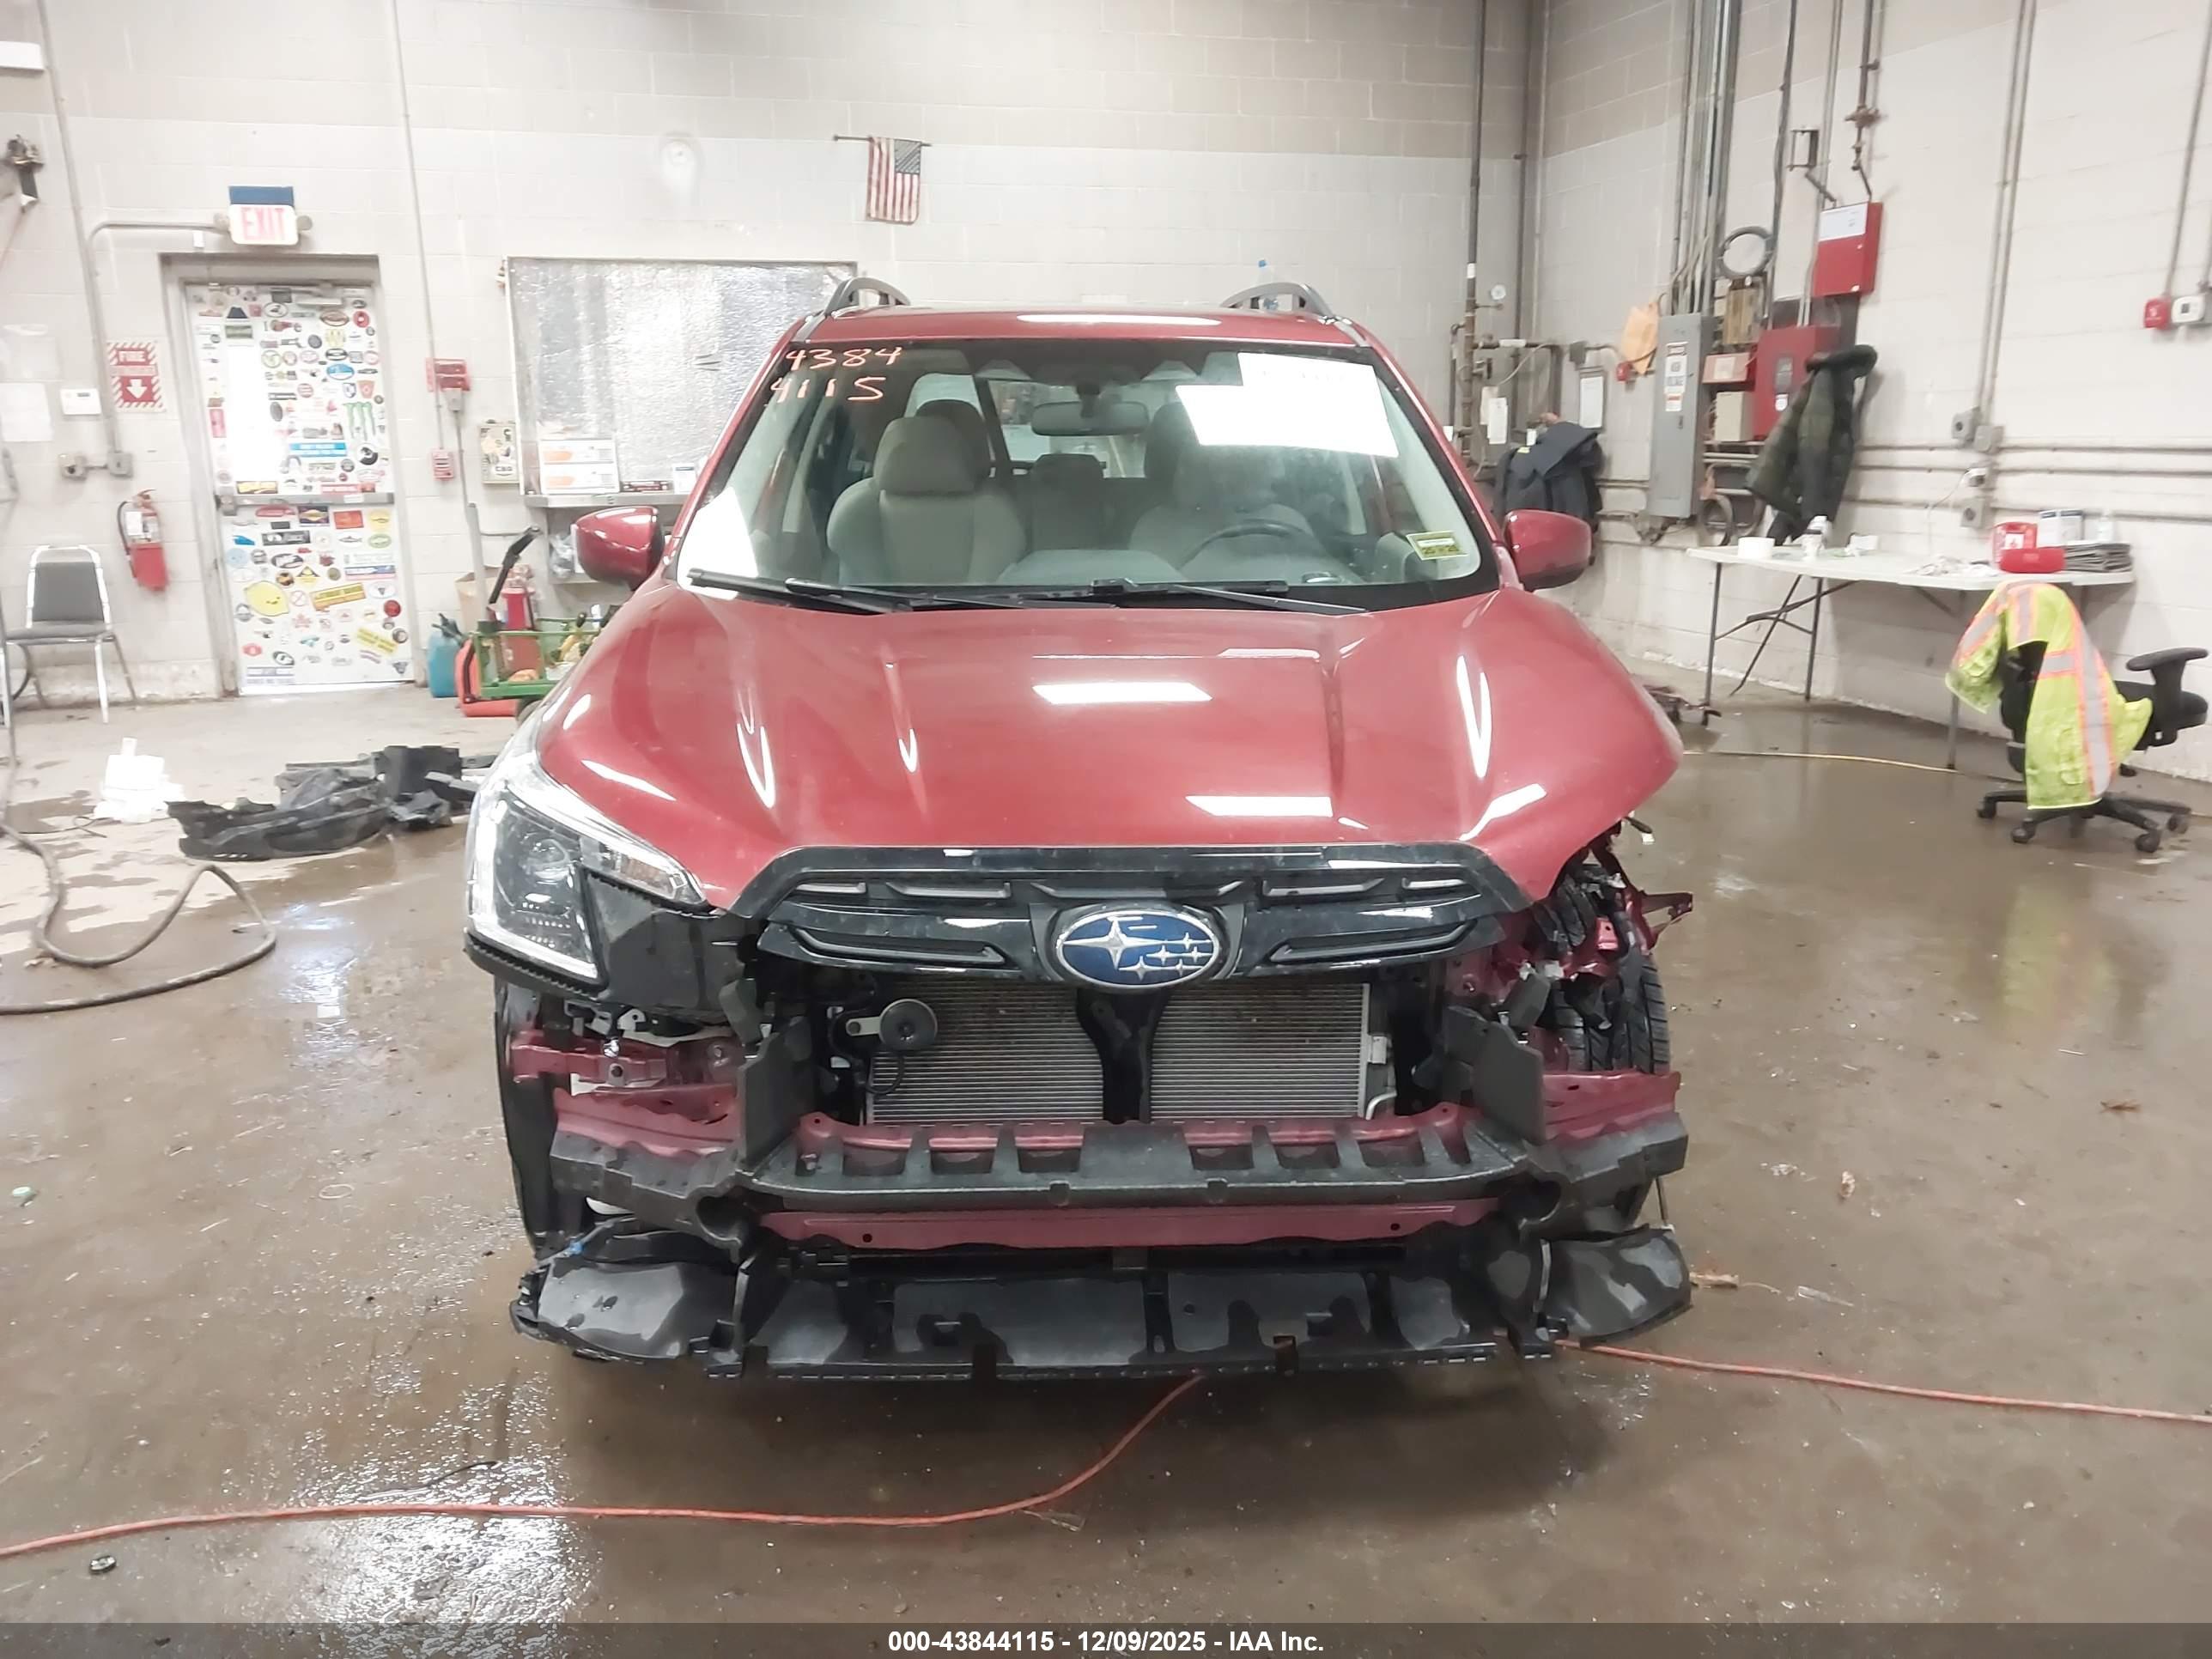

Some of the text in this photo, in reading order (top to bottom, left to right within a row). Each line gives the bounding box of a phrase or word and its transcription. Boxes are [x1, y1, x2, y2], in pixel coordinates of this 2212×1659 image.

[240, 207, 285, 240] EXIT
[786, 347, 902, 371] 4384
[770, 376, 886, 404] 4115
